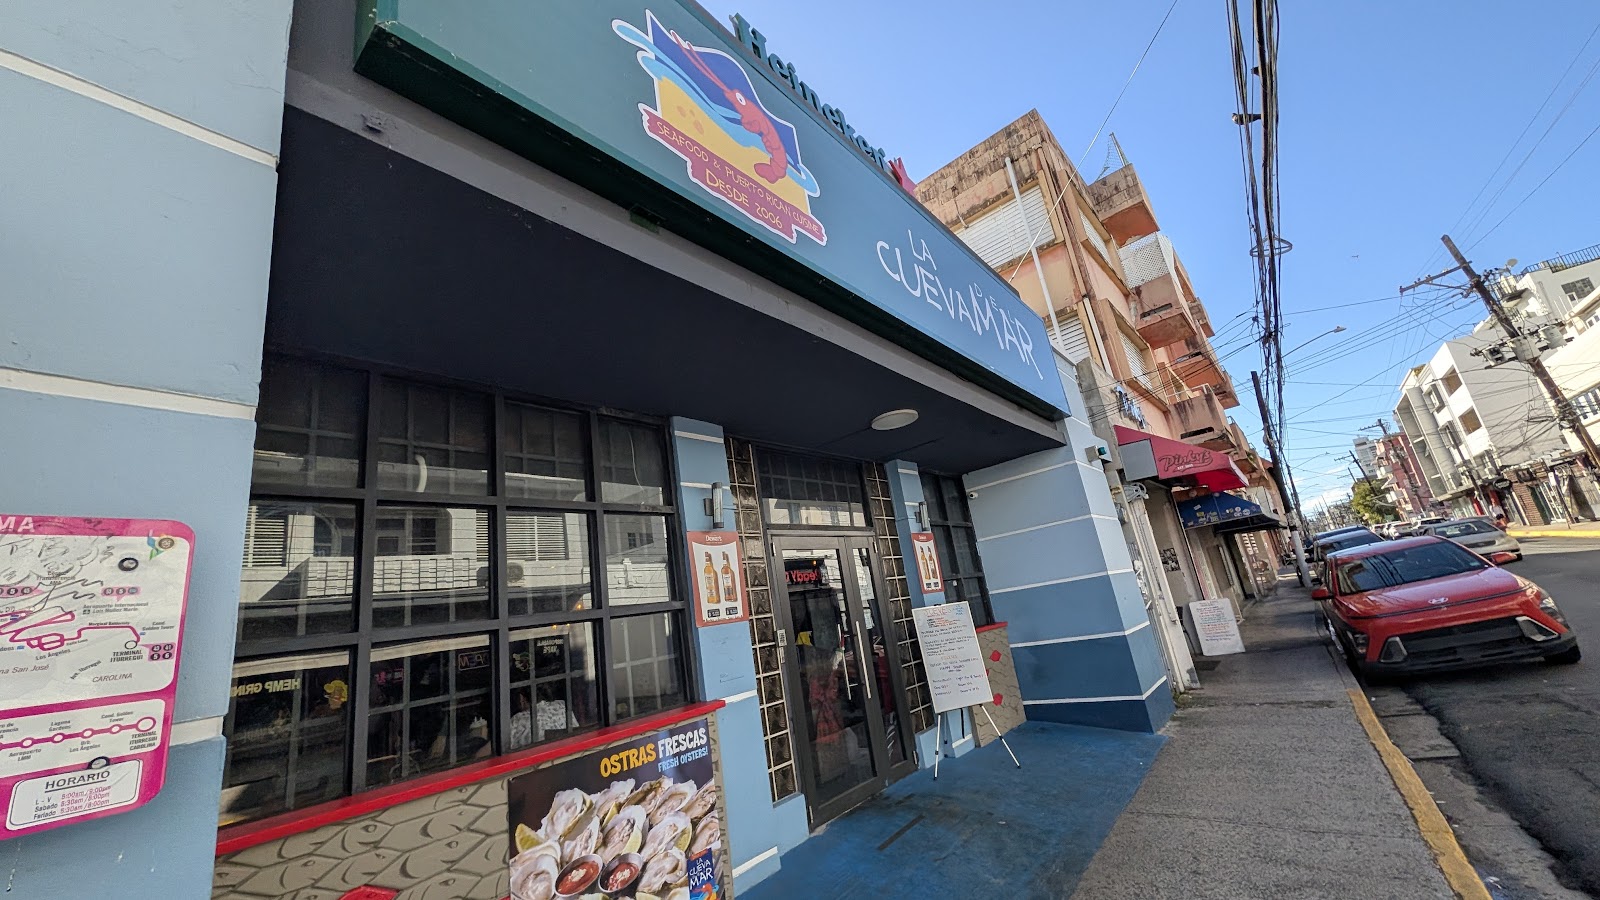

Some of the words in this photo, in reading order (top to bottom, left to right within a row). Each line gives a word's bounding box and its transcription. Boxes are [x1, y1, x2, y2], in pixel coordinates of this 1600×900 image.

[729, 13, 887, 170] Heineken
[657, 121, 709, 163] SEAFOOD
[713, 159, 722, 171] &
[725, 166, 764, 198] PUERTO
[766, 191, 792, 216] RICAN
[793, 206, 820, 234] CUISINE
[705, 168, 749, 207] DESDE
[755, 202, 783, 228] 2006
[908, 229, 937, 270] LA
[876, 240, 977, 331] CUEVA
[969, 284, 1044, 380] MAR
[12, 666, 28, 674] San
[30, 663, 49, 672] José
[92, 673, 133, 683] CAROLINA
[600, 743, 657, 778] OSTRAS
[657, 727, 708, 759] FRESCAS
[658, 755, 680, 773] FRESH
[680, 746, 709, 764] OYSTERS!
[45, 770, 111, 790] HORARIO
[689, 859, 711, 876] CUEVA
[689, 867, 713, 890] MAR
